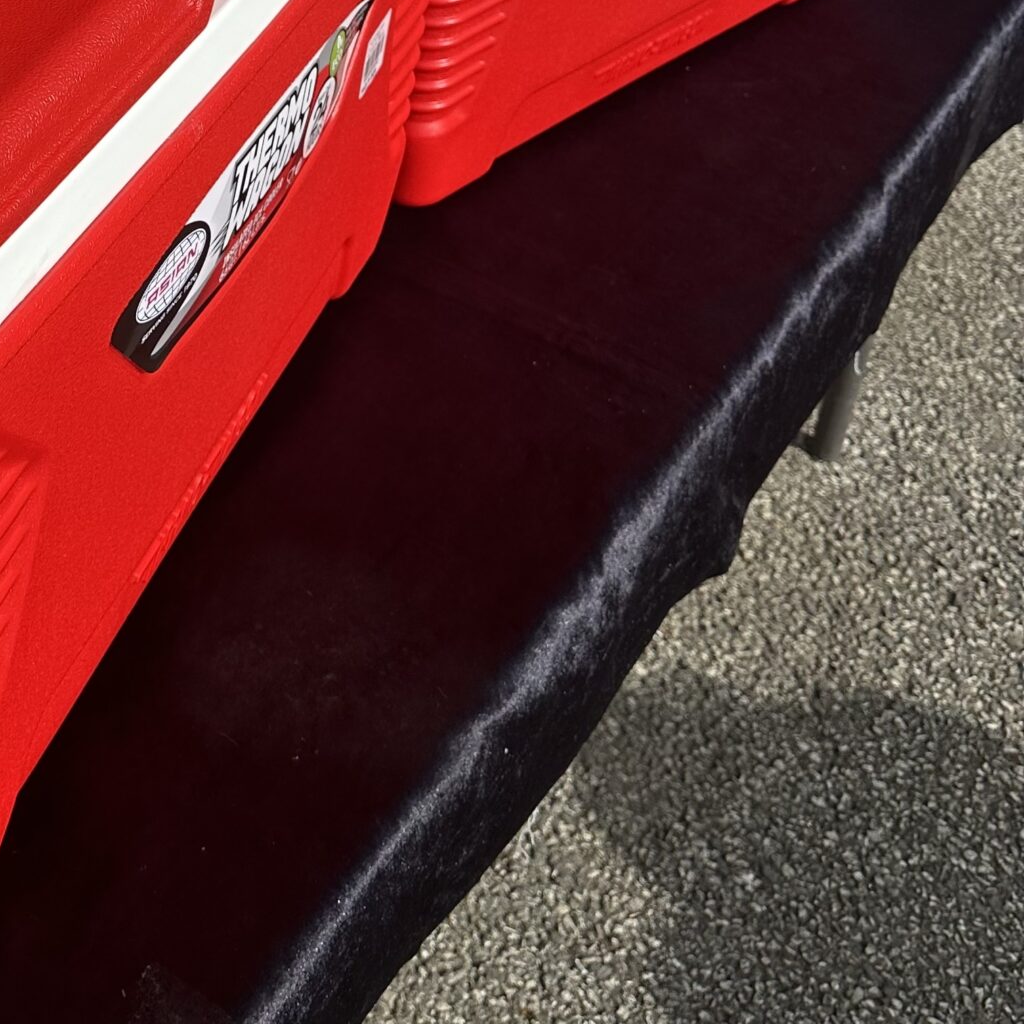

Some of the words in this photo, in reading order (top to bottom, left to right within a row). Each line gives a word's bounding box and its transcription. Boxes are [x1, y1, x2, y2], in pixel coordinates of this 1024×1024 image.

[222, 106, 310, 251] WAGON
[233, 65, 318, 202] THERMO
[147, 241, 199, 308] ASIAN
